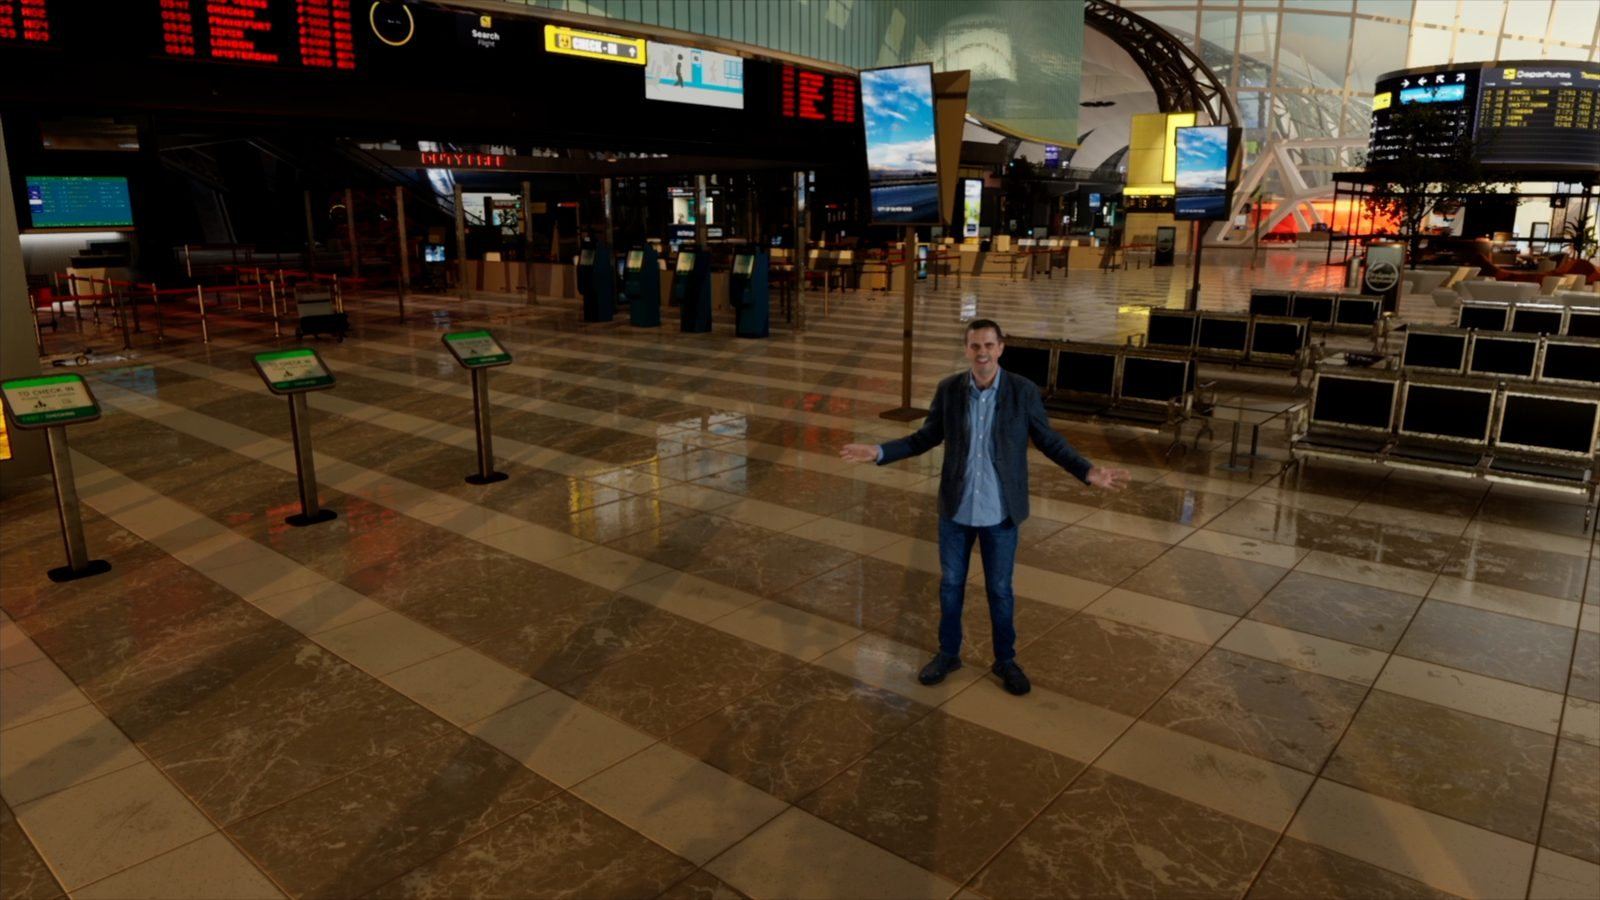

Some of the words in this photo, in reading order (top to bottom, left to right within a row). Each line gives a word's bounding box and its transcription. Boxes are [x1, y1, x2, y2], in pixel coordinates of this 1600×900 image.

[208, 15, 272, 31] FRANKFURT
[471, 29, 501, 41] Search
[210, 37, 255, 51] LONDON
[477, 39, 496, 48] Flight
[211, 48, 279, 63] AMSTERDAM
[1517, 70, 1572, 79] Departures
[32, 387, 62, 396] CHECK
